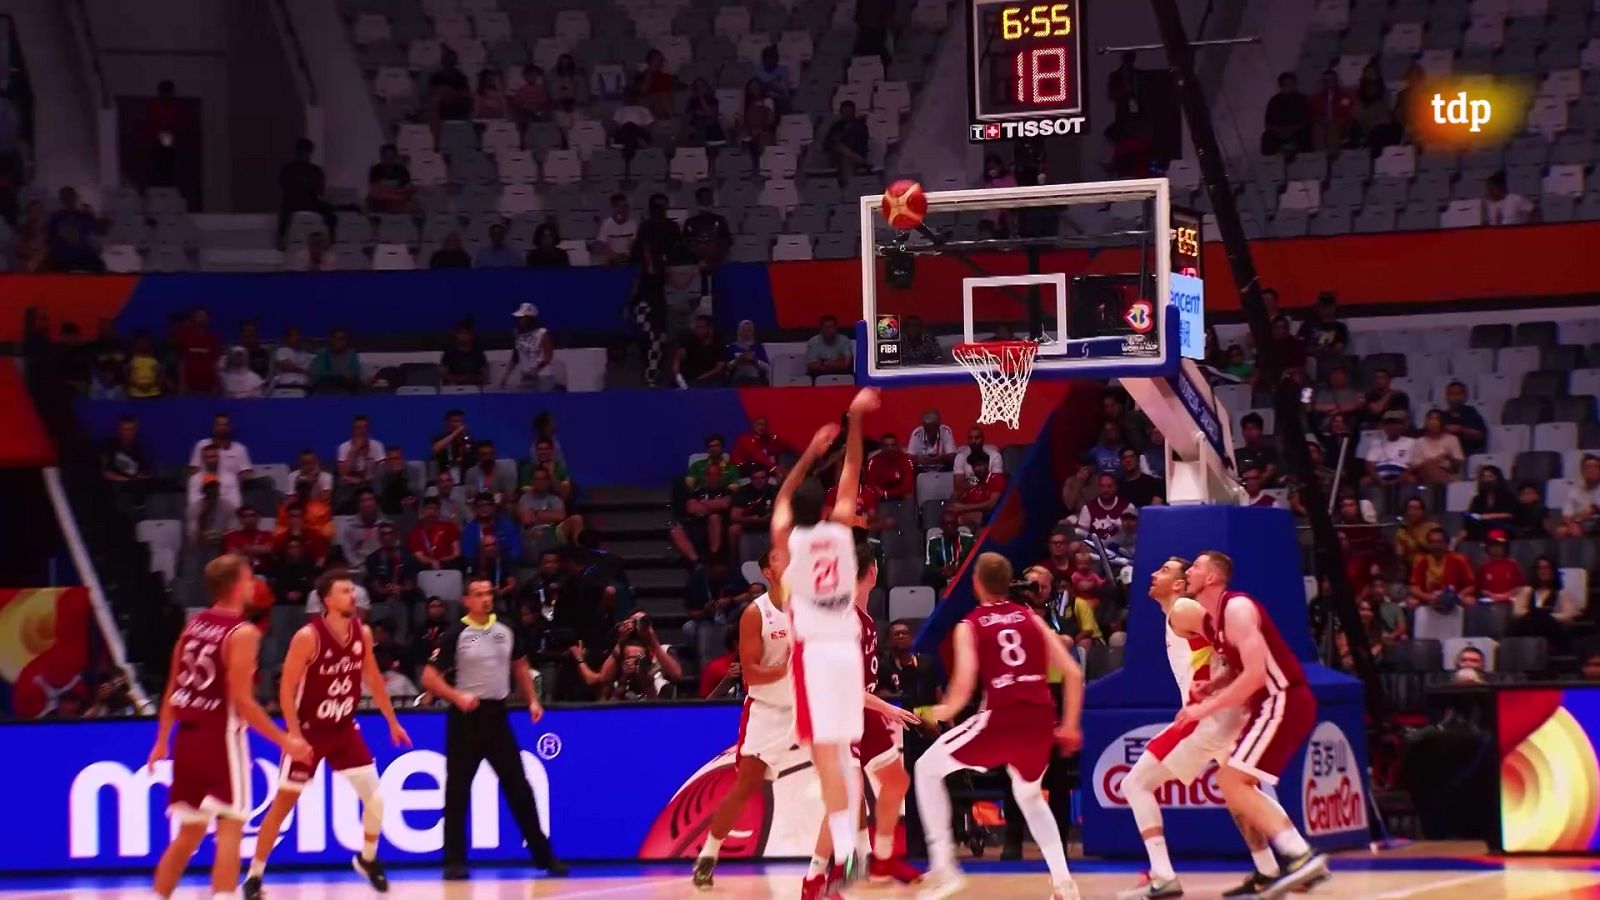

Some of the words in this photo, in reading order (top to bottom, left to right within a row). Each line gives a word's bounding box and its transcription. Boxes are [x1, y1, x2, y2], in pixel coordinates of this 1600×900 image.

[1002, 4, 1071, 40] 6:55
[1016, 48, 1066, 103] 18
[1002, 117, 1085, 138] TISSOT
[880, 344, 898, 354] FIBA
[176, 639, 217, 692] 55
[997, 629, 1027, 667] 8
[327, 674, 353, 697] 66
